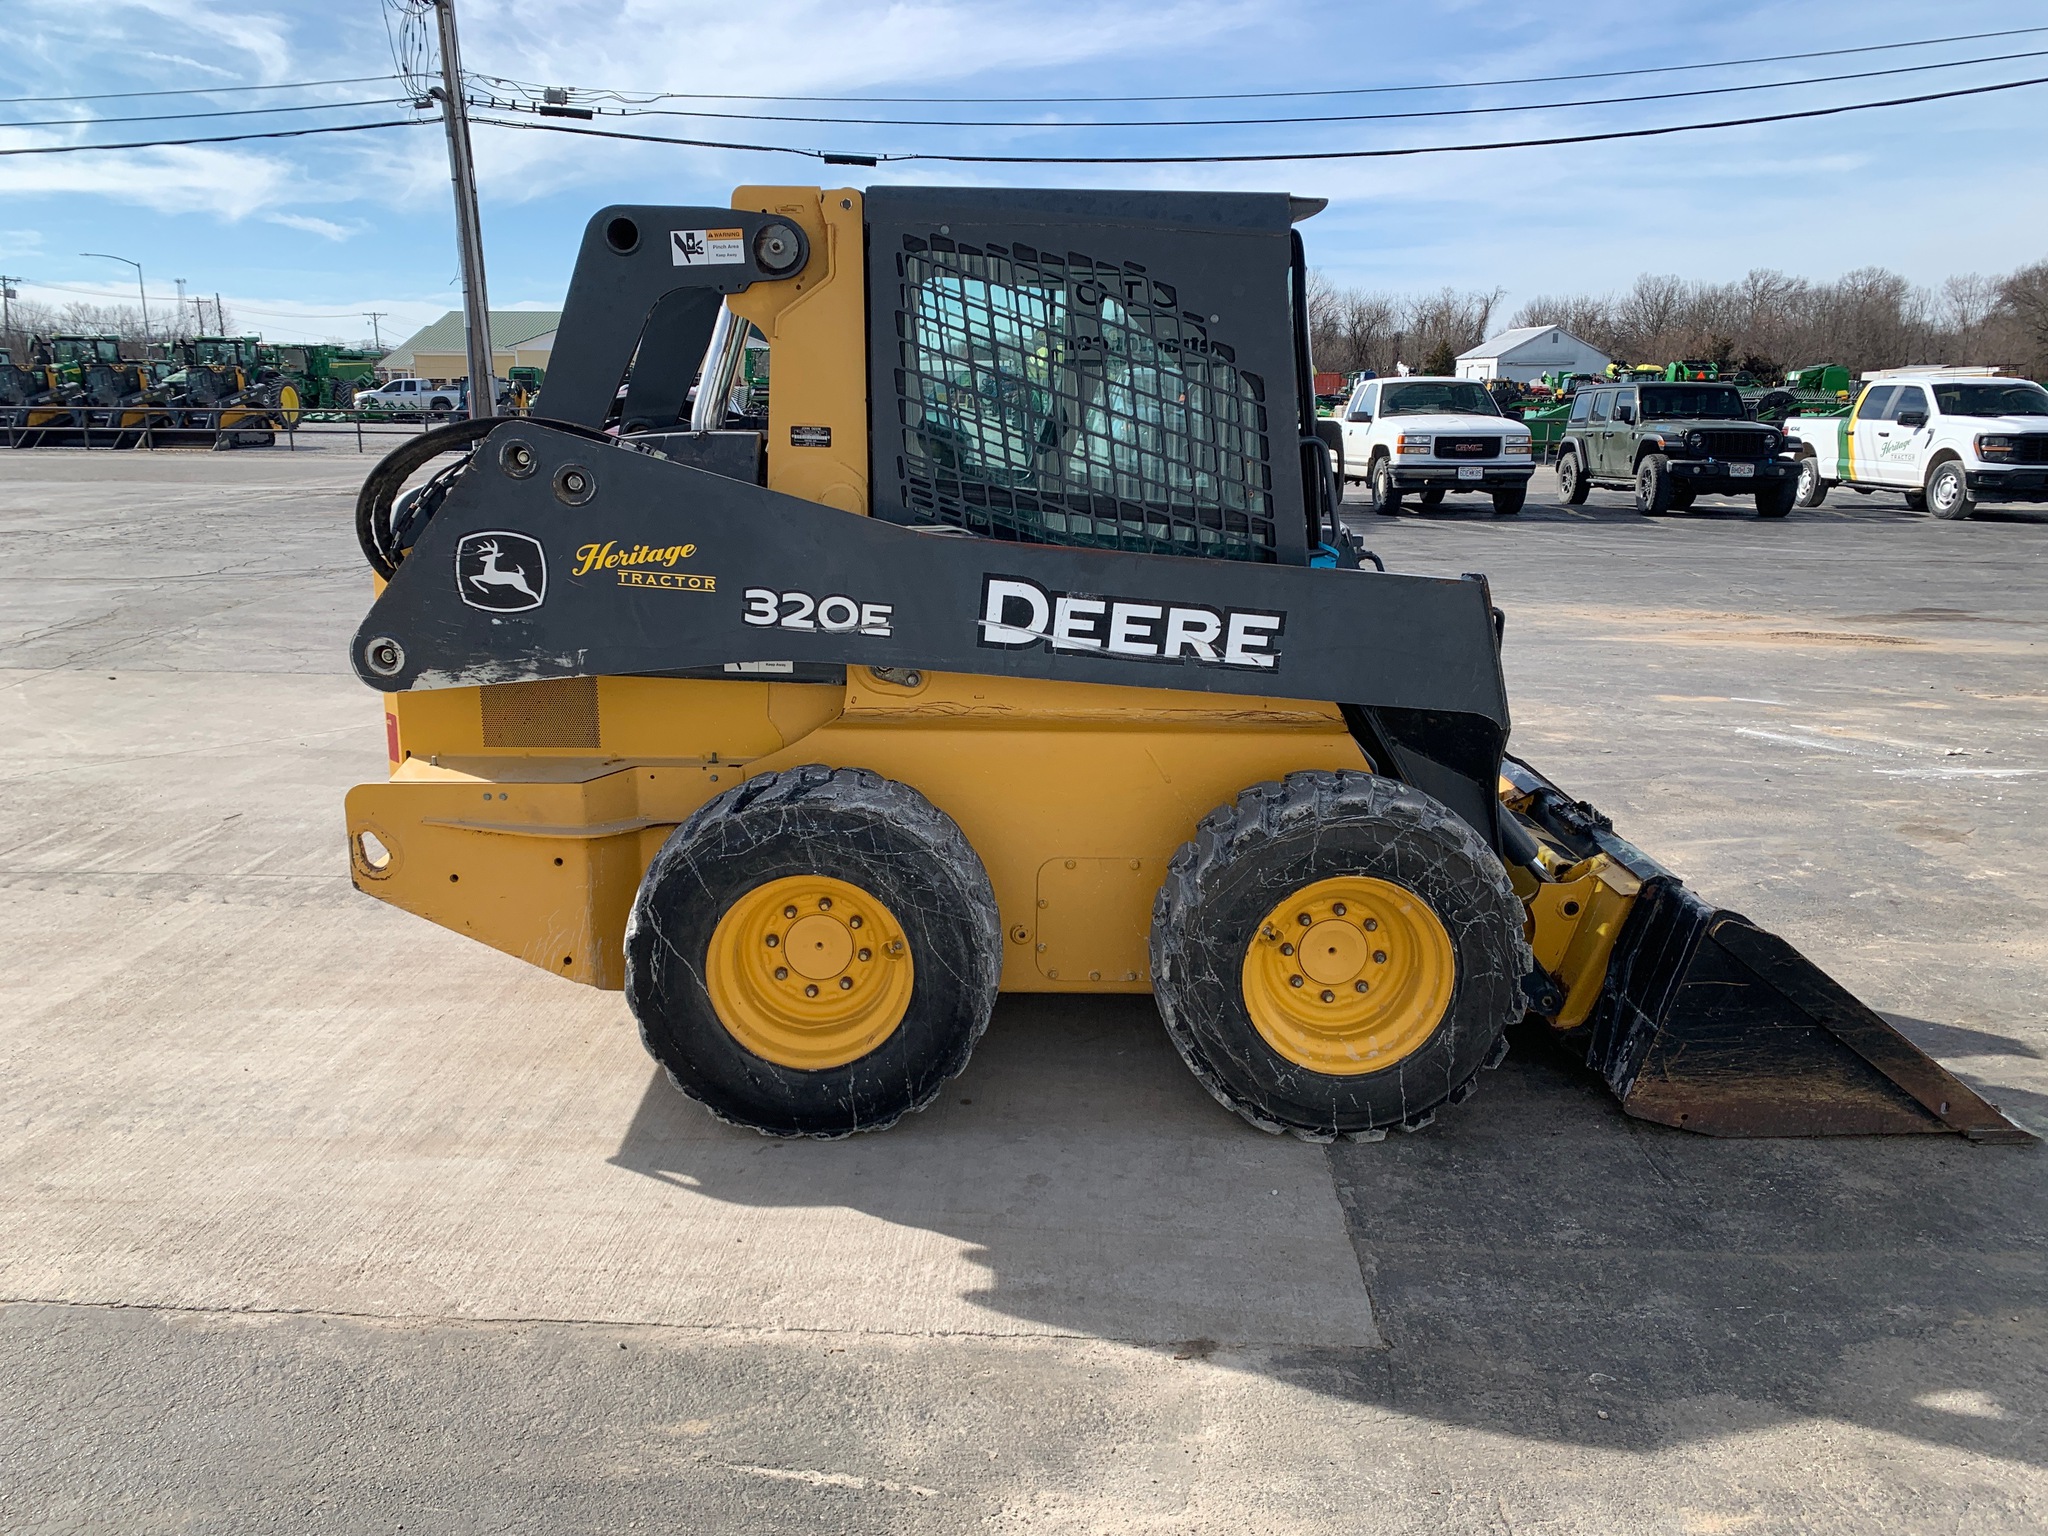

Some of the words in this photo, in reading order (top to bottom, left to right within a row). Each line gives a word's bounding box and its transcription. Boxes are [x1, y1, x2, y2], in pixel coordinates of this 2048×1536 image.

[1455, 443, 1484, 452] GMC
[1879, 438, 1912, 458] Heritage
[572, 540, 698, 576] Heritage
[617, 571, 716, 590] TRACTOR
[743, 588, 893, 637] 320E
[983, 578, 1281, 668] DEERE
